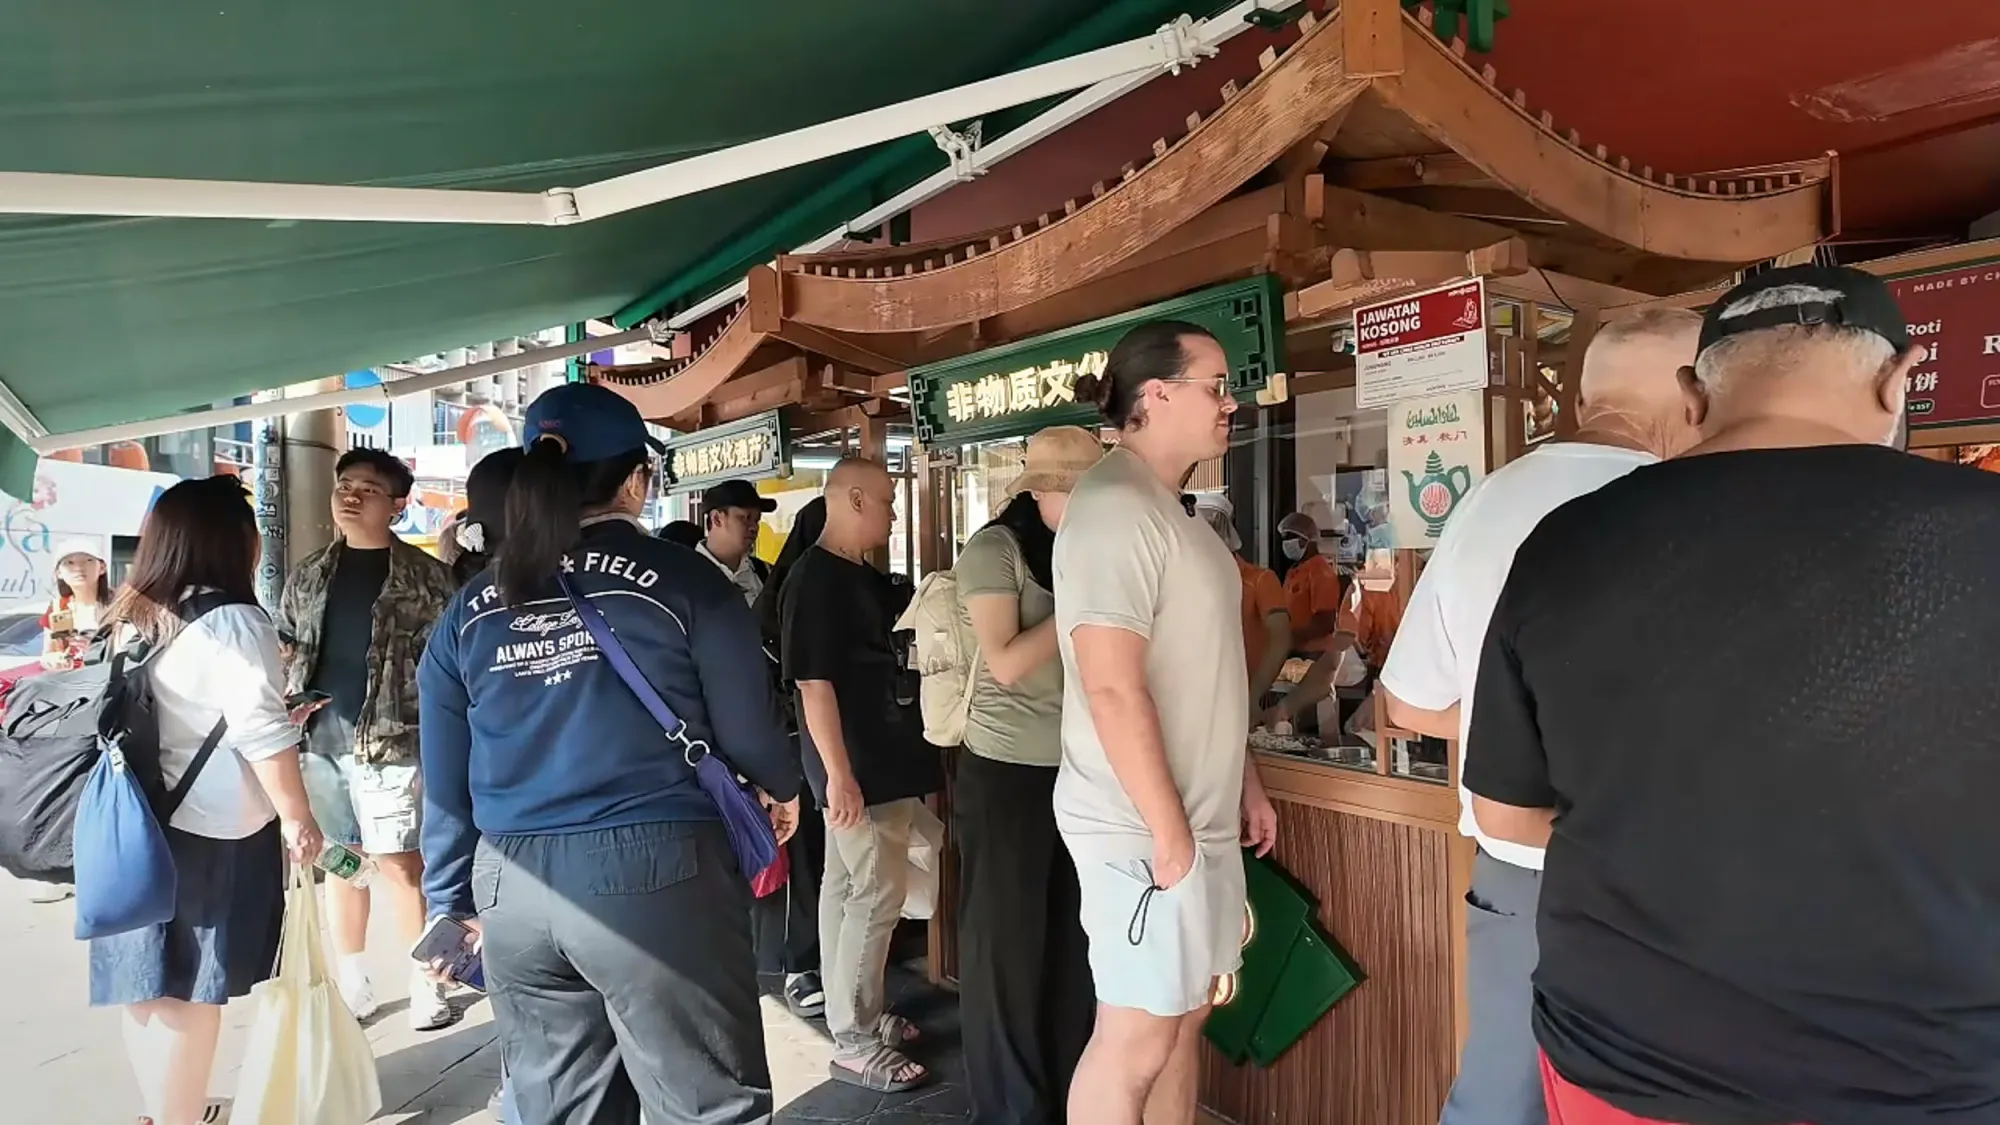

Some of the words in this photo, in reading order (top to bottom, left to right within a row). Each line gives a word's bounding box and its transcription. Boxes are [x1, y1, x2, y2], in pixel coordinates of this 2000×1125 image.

[1913, 279, 1954, 293] MADE
[1960, 275, 1978, 286] BY
[1360, 300, 1421, 327] JAWATAN
[1360, 315, 1421, 342] KOSONG
[1906, 319, 1942, 336] Roti
[467, 584, 504, 612] TR
[584, 552, 660, 589] FIELD
[496, 640, 556, 664] ALWAYS
